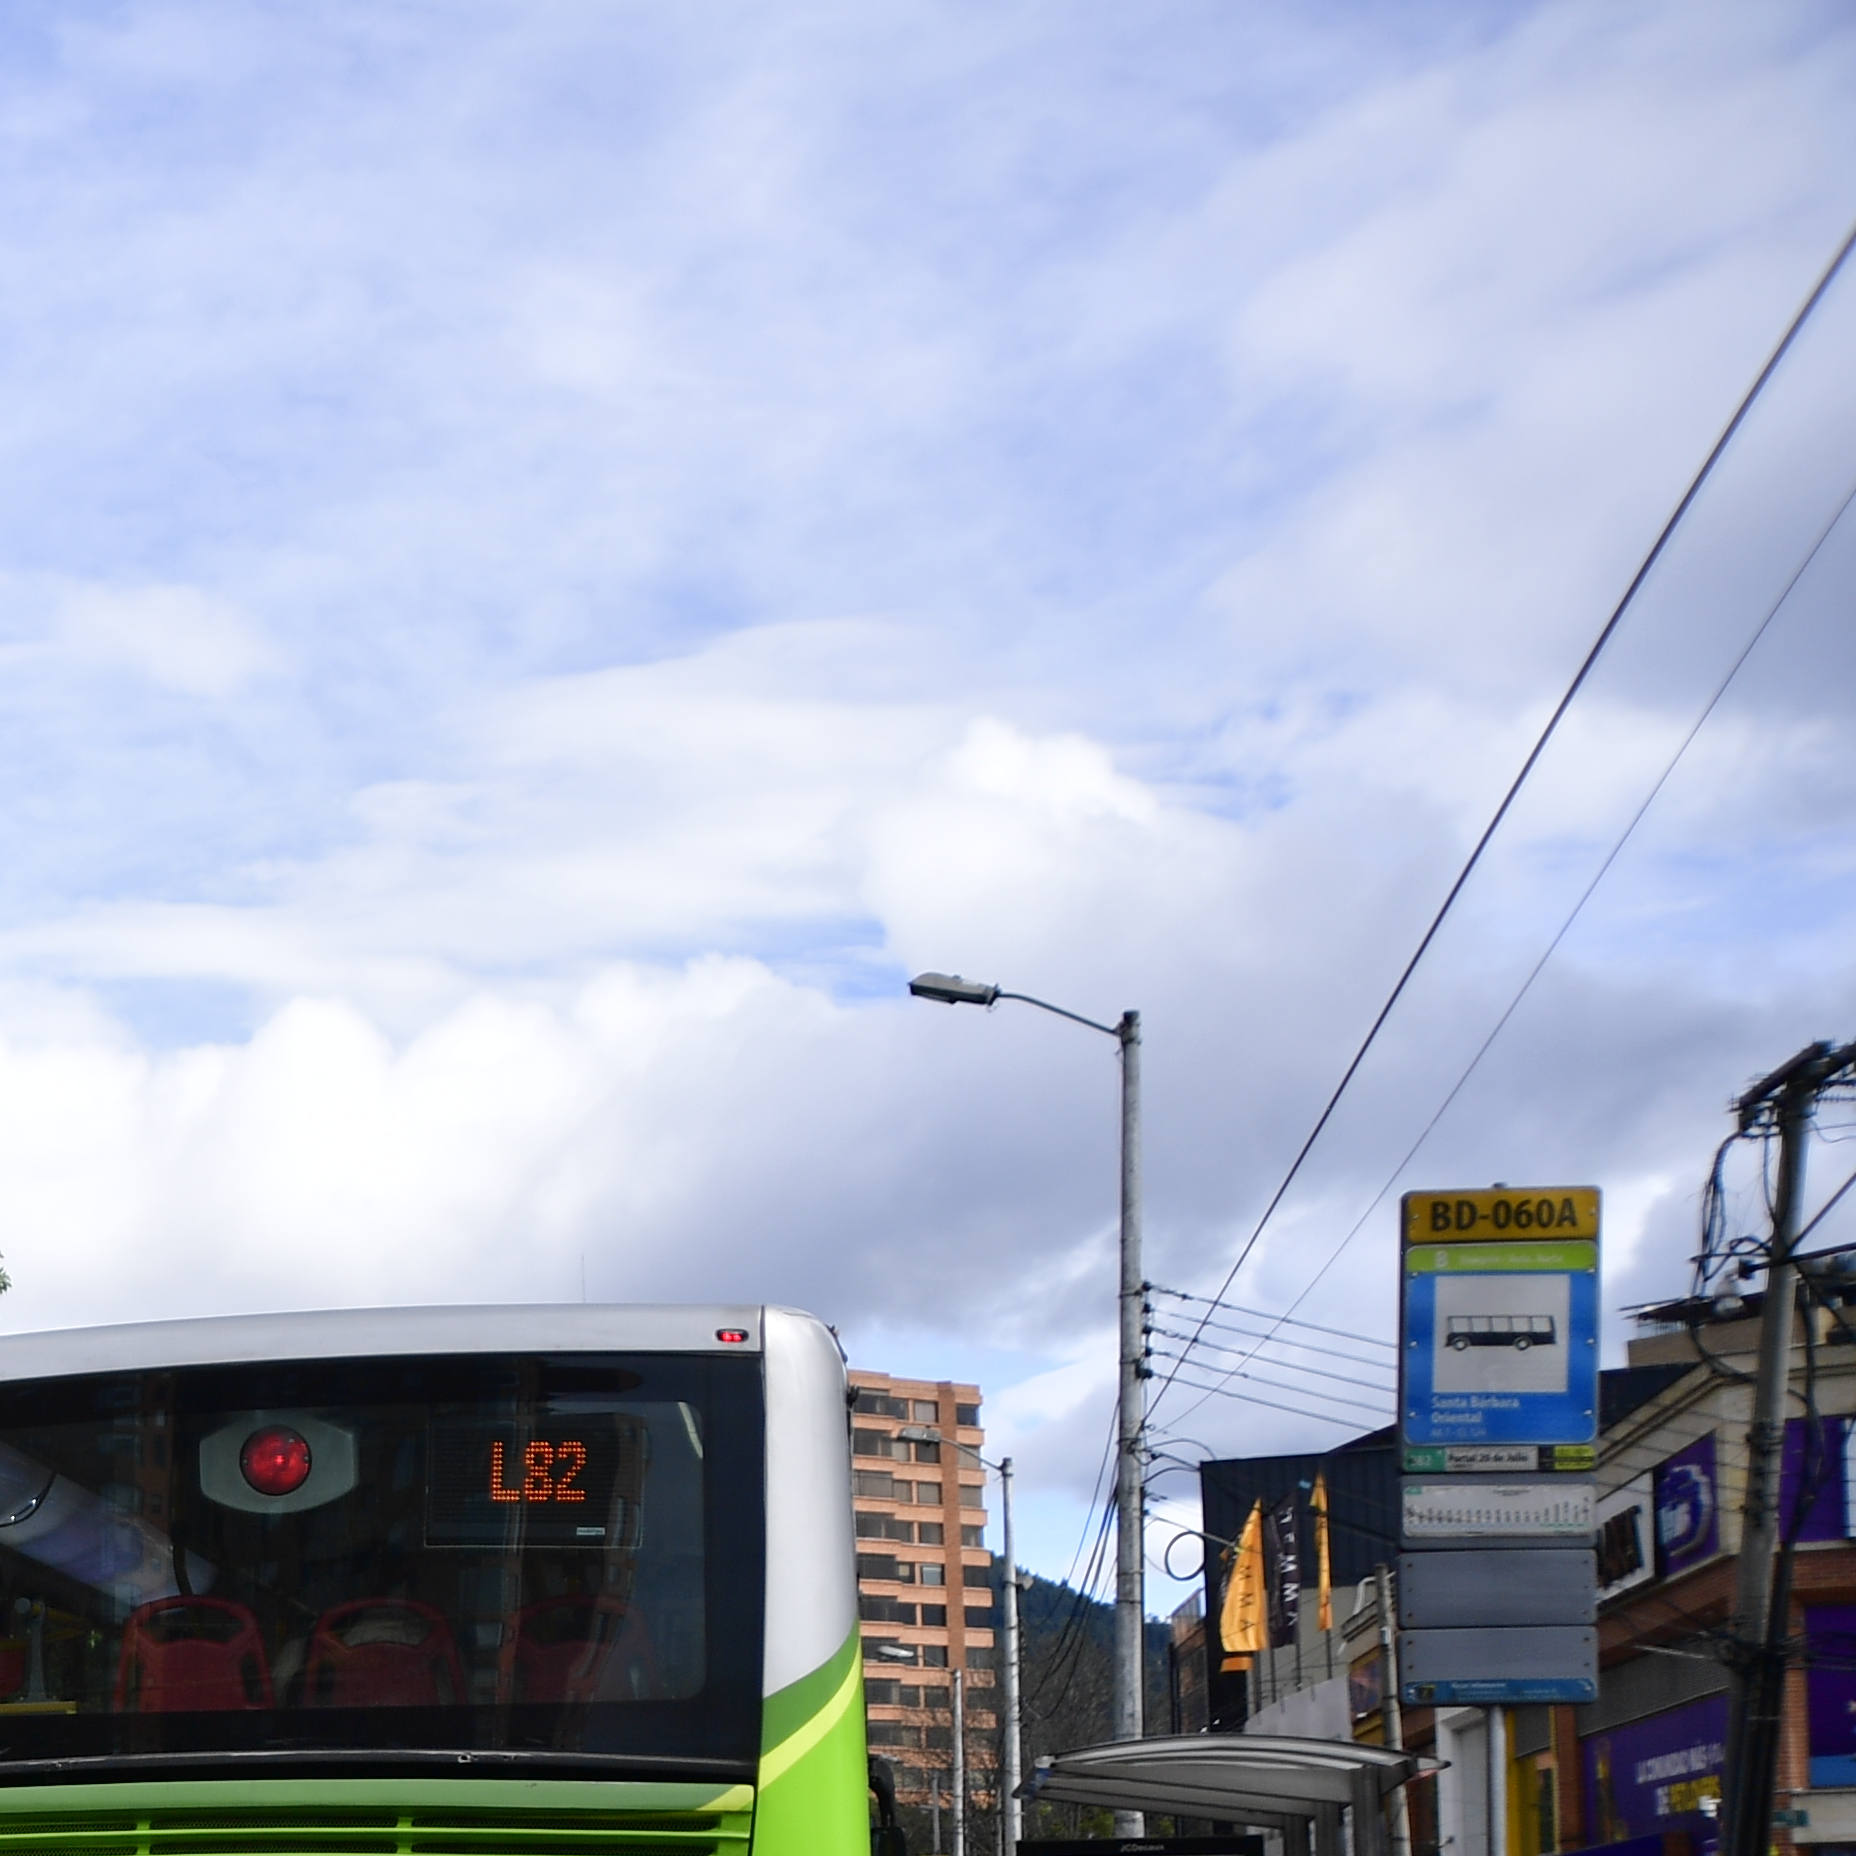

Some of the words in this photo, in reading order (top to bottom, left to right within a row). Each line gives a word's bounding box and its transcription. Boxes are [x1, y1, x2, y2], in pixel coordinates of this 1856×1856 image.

[1431, 1197, 1577, 1232] BD-060A
[492, 1440, 587, 1502] L82
[1506, 1453, 1528, 1462] Julio
